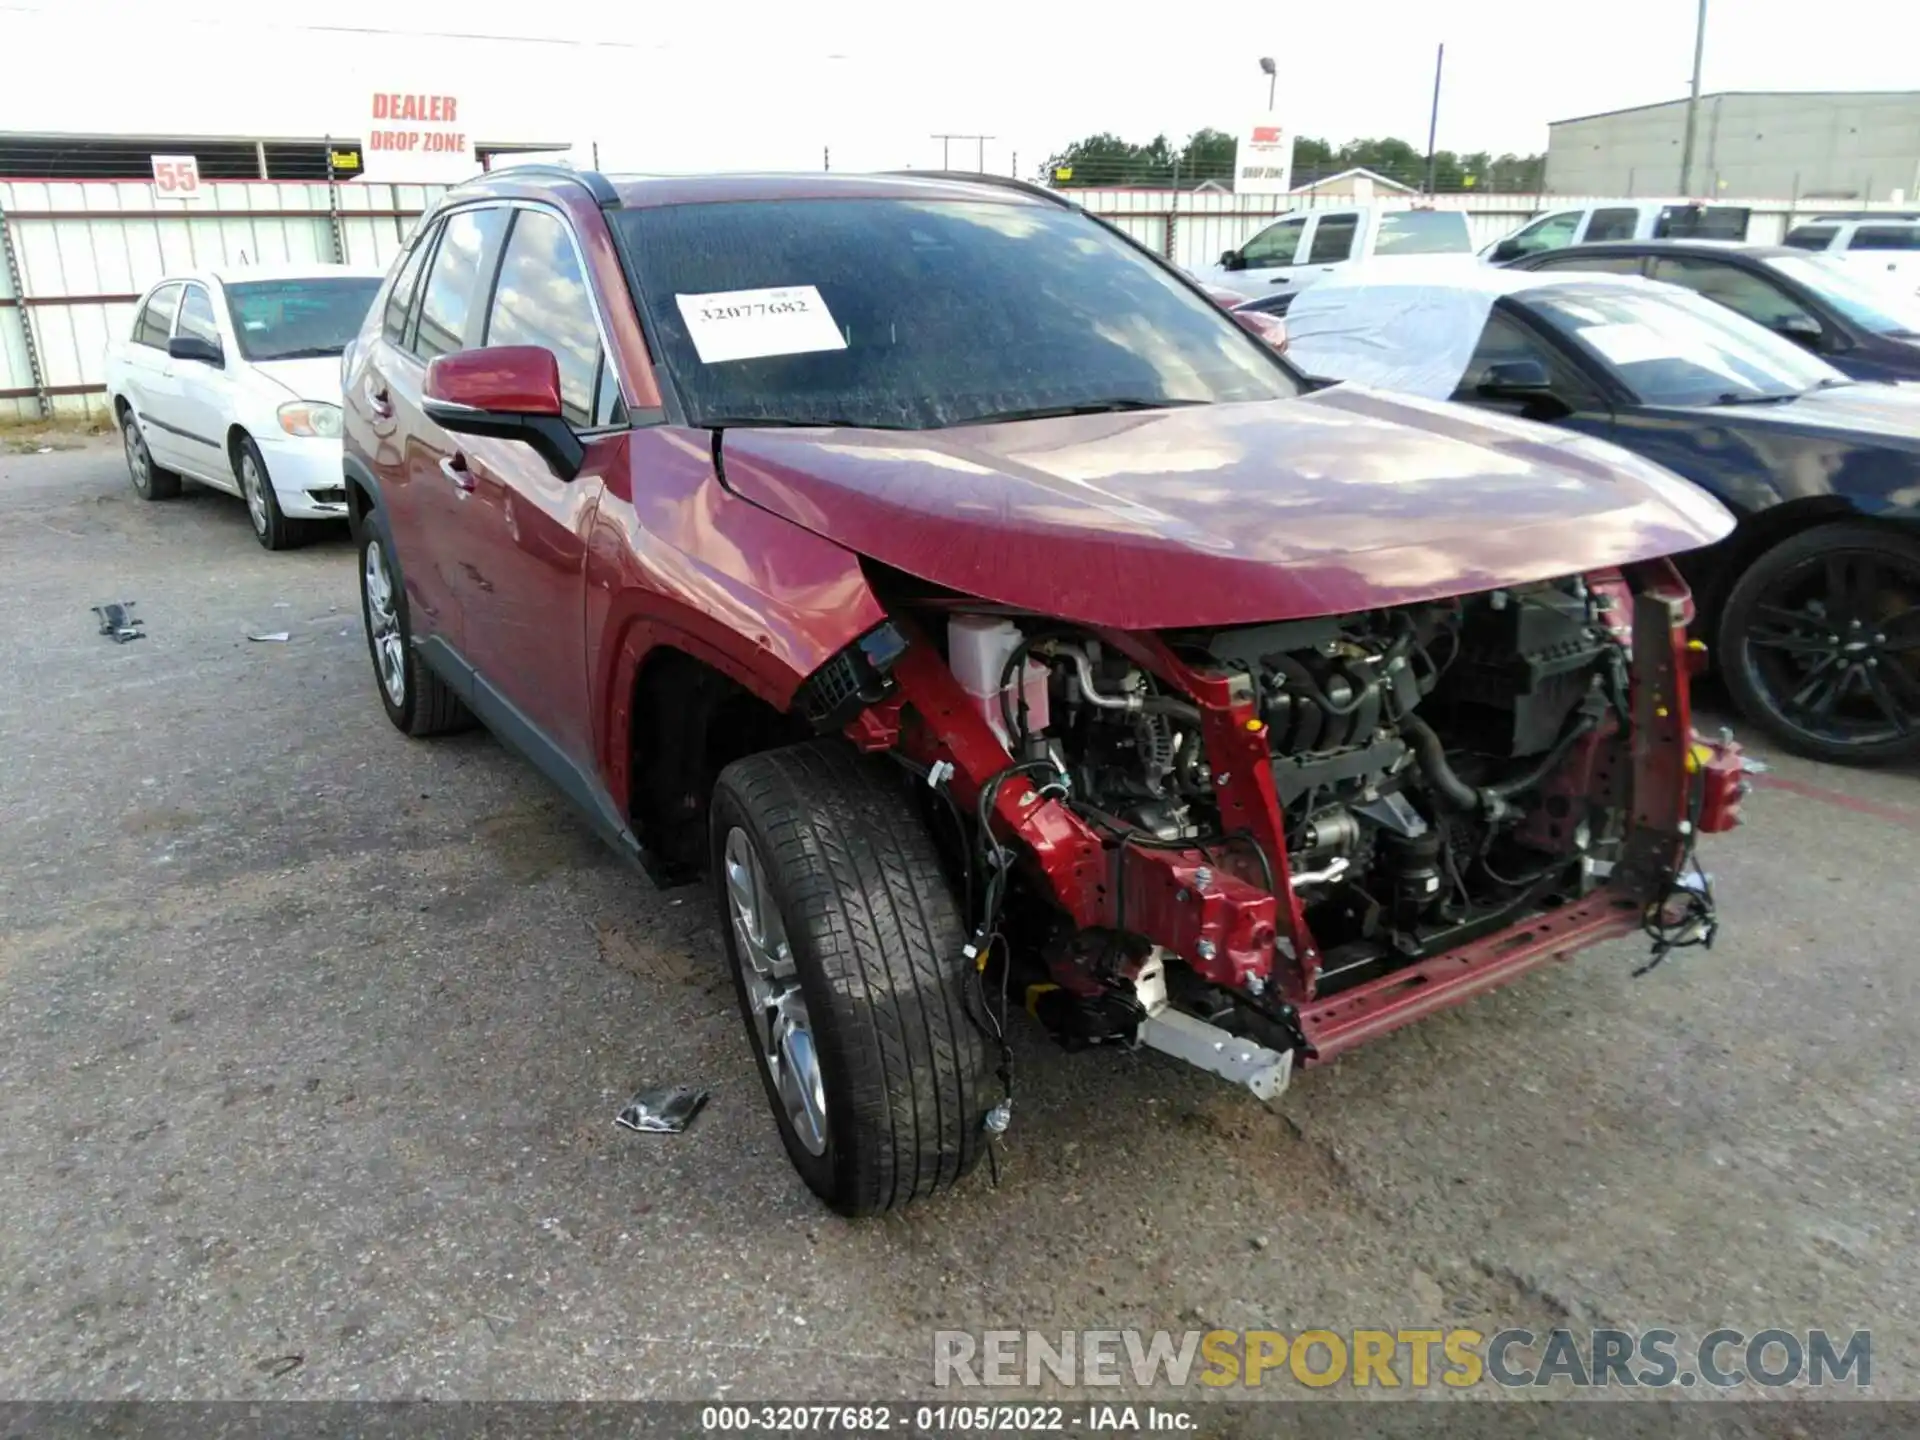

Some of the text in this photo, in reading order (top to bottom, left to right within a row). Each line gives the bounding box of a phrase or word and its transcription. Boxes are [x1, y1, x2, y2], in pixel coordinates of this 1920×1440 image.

[372, 93, 457, 122] DEALER
[370, 130, 466, 152] DROP ZONE
[156, 163, 196, 191] 55
[700, 300, 809, 322] 32077682
